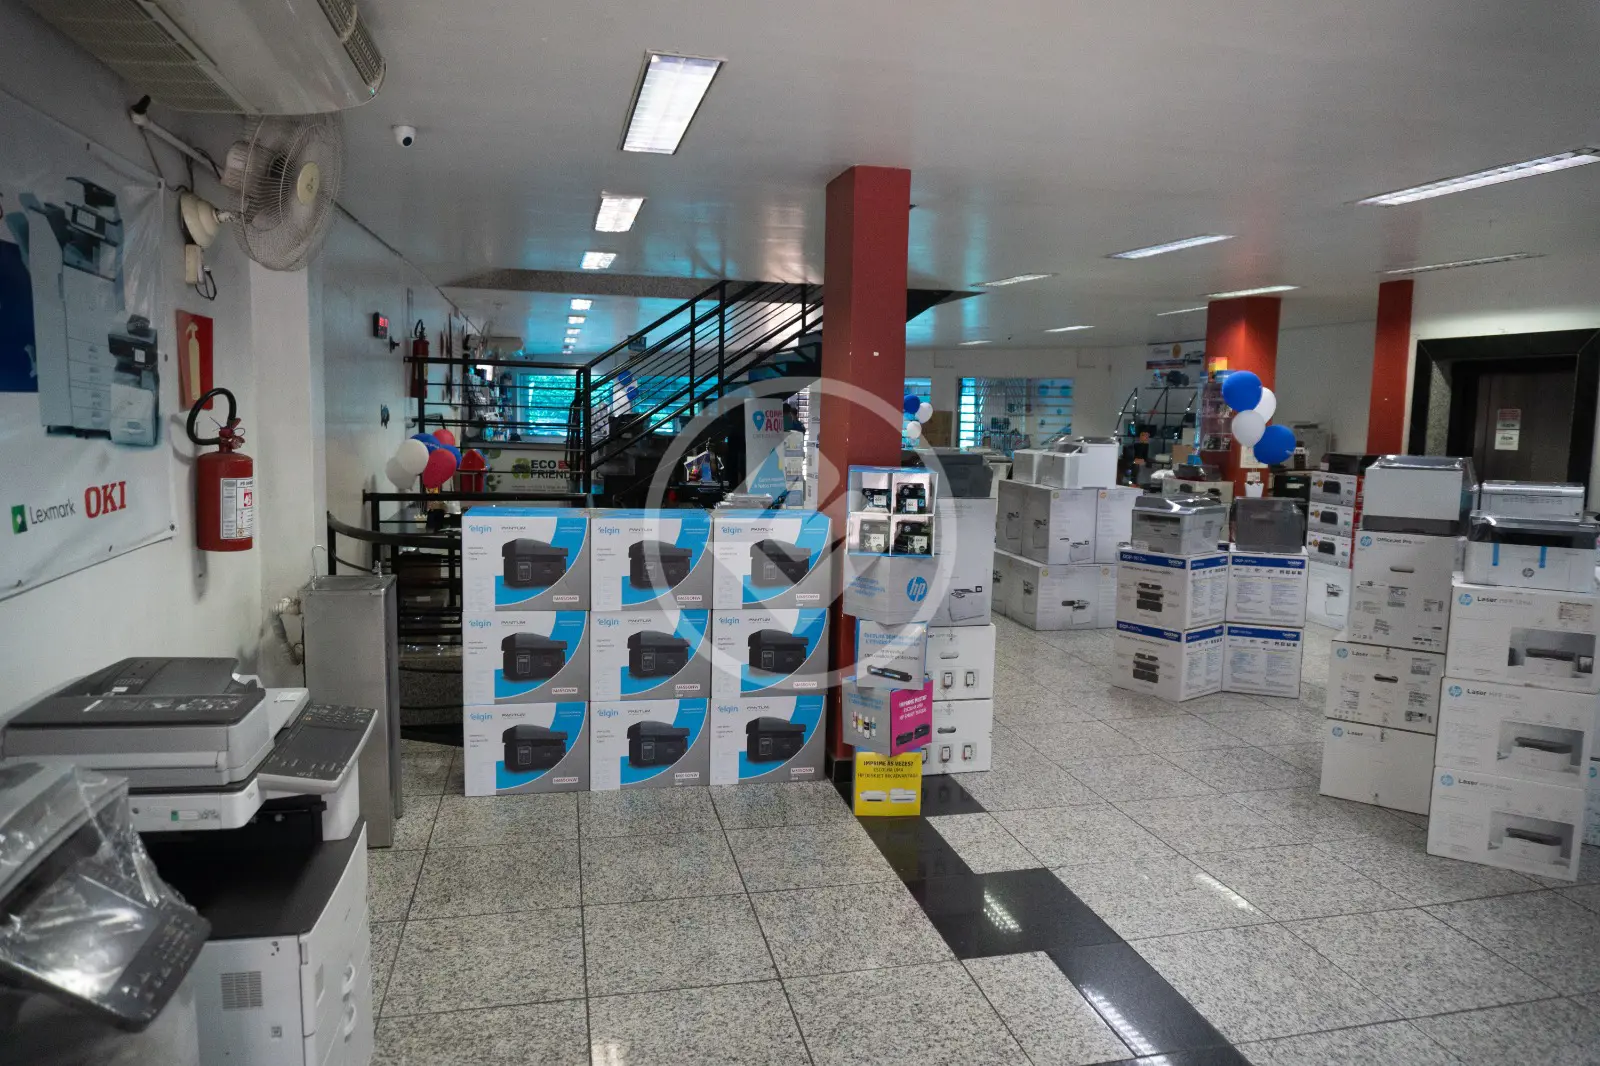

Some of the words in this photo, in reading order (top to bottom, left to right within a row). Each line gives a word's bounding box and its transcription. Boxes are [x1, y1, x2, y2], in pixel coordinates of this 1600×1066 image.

[531, 459, 556, 469] ECO
[84, 480, 127, 519] OKI
[29, 498, 76, 525] Lexmark
[468, 525, 492, 534] elgin
[598, 527, 620, 536] elgin
[721, 526, 743, 535] elgin
[907, 576, 928, 603] hp
[468, 619, 492, 628] elgin
[598, 618, 619, 627] elgin
[718, 617, 740, 626] elgin
[1467, 688, 1487, 696] Laser
[597, 709, 619, 718] elgin
[718, 705, 739, 714] elgin
[469, 713, 493, 722] elgin
